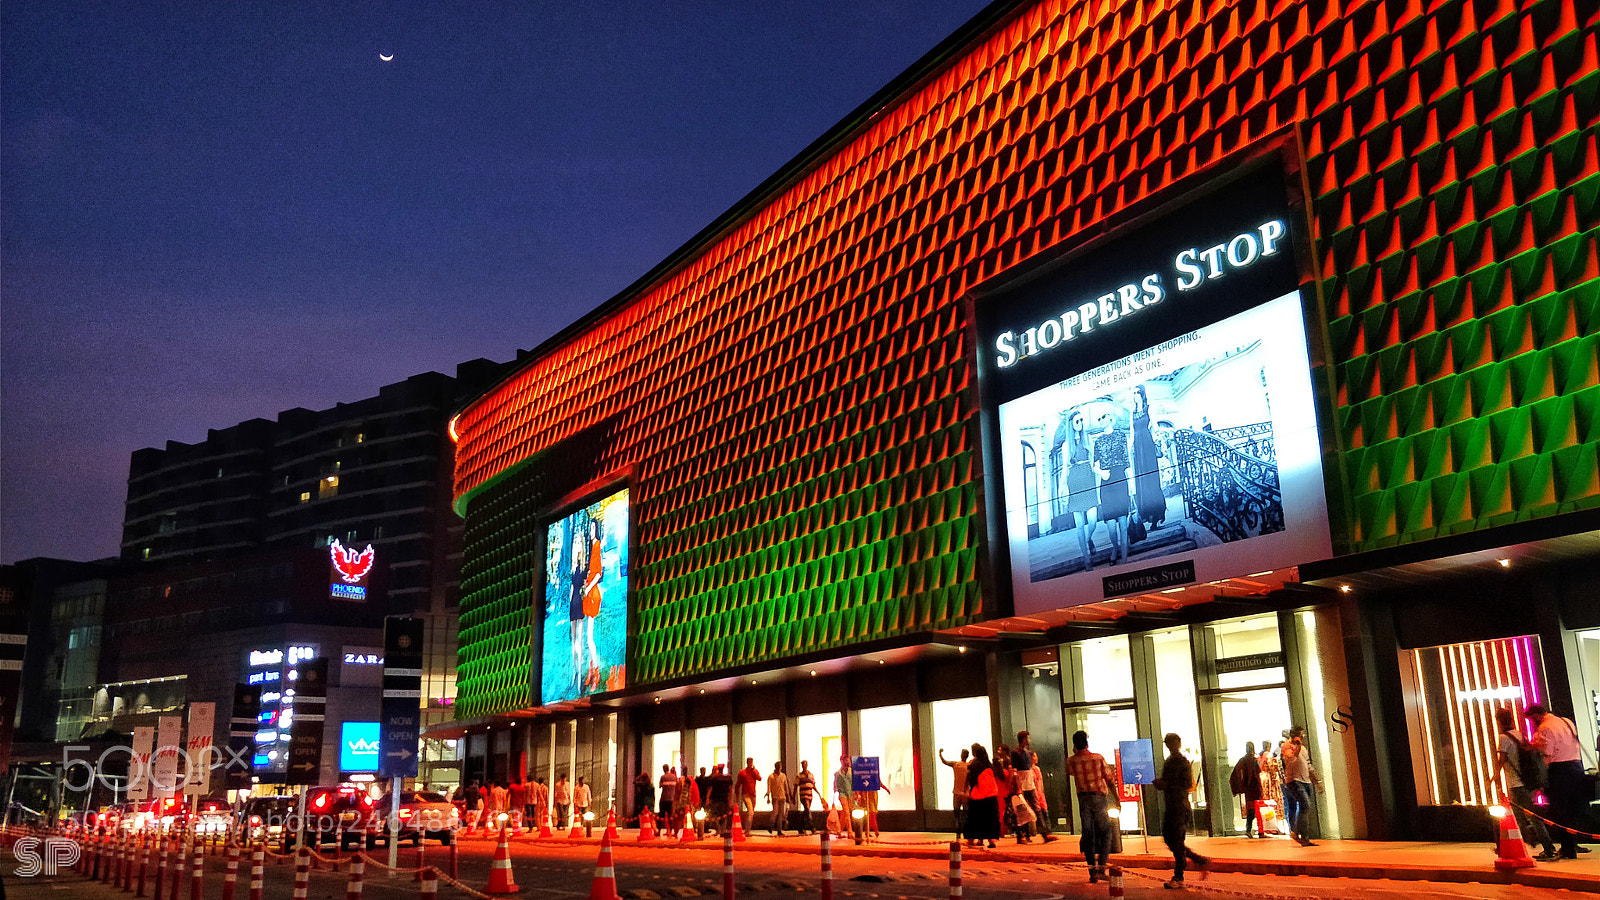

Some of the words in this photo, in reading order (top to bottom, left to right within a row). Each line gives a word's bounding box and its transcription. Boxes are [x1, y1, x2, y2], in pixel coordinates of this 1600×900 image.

[996, 272, 1164, 368] SHOPPERS
[1175, 219, 1286, 291] STOP
[1059, 376, 1081, 390] THREE
[1083, 356, 1131, 382] GENERATIONS
[1133, 347, 1155, 363] WENT
[1113, 371, 1132, 384] BACK
[1134, 366, 1144, 376] AS
[1107, 575, 1158, 592] SHOPPERS
[1161, 568, 1190, 582] STOP
[333, 583, 366, 596] PHOENIX
[390, 717, 412, 726] NOW
[389, 731, 413, 740] OPEN
